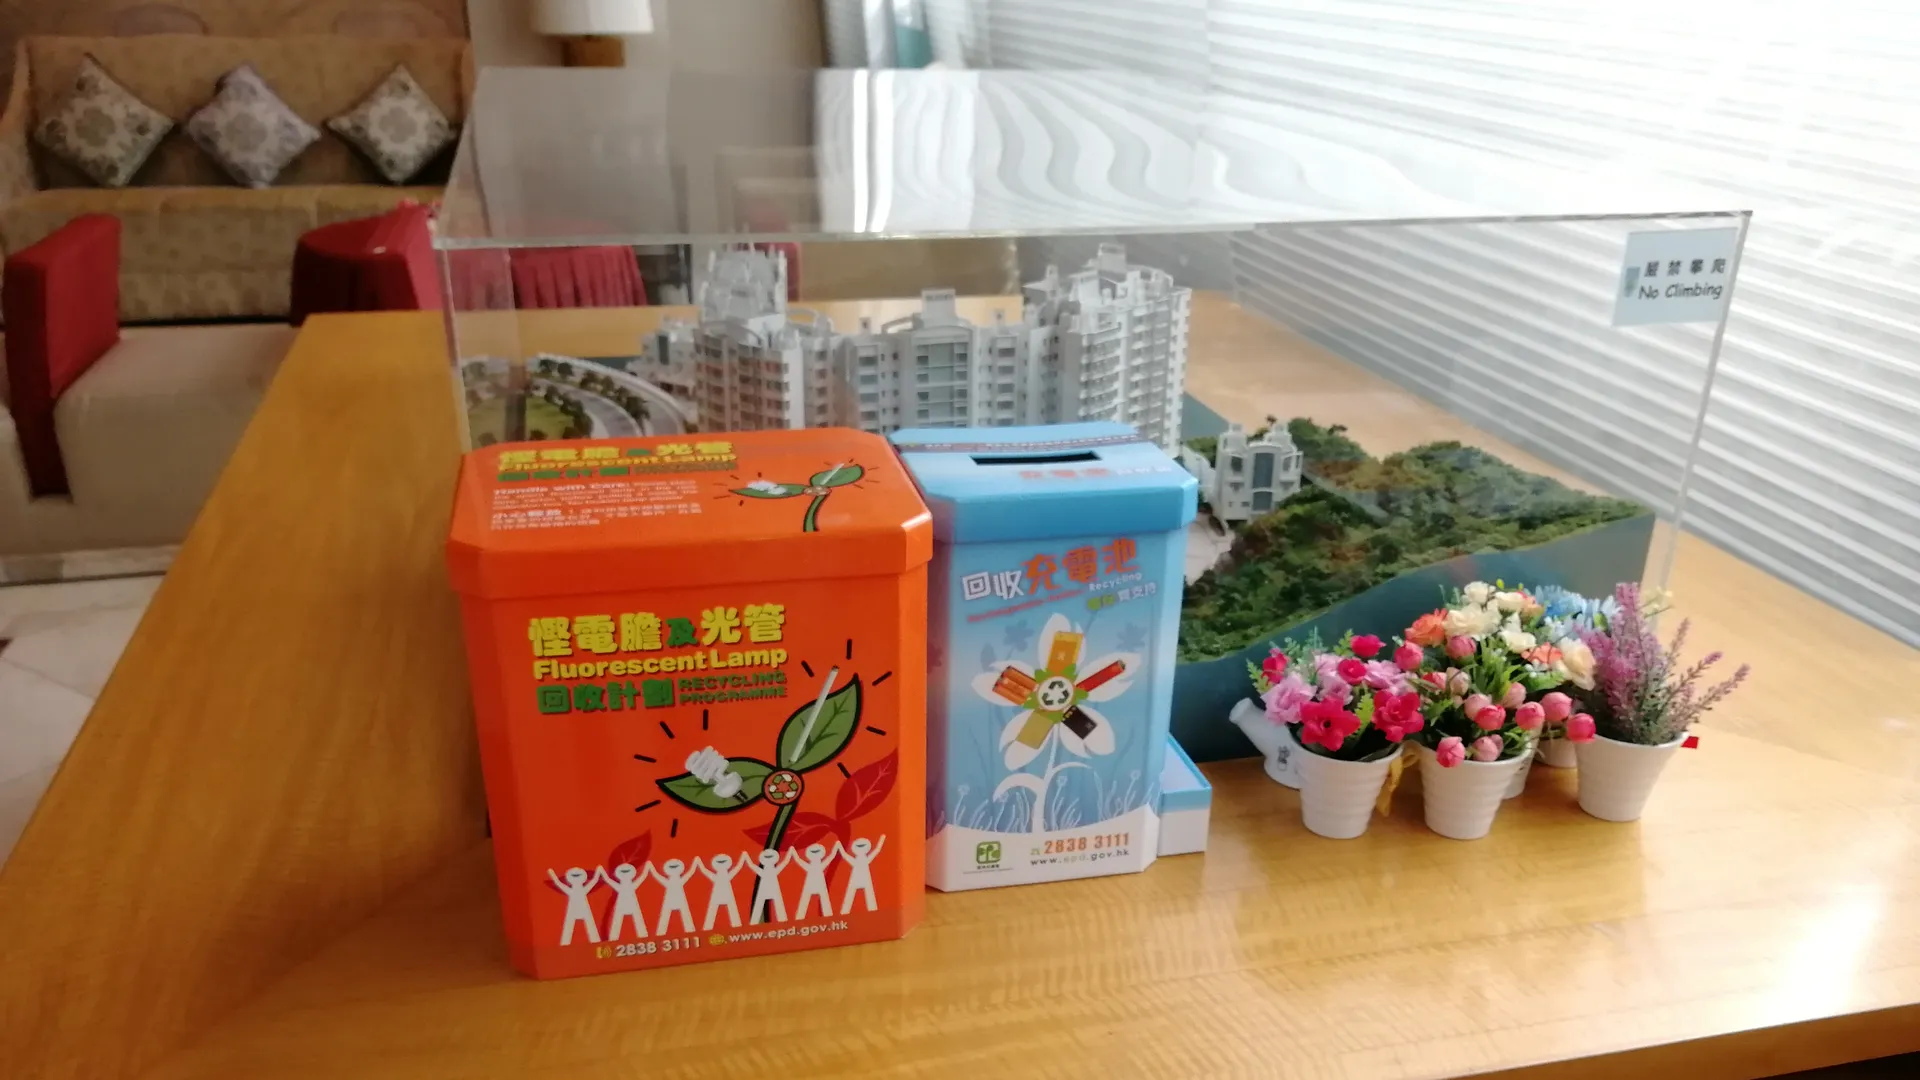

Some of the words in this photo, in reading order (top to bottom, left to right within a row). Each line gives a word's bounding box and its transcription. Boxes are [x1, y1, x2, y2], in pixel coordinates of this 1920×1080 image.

[1638, 285, 1659, 300] No
[1665, 281, 1723, 300] Climbing
[533, 654, 707, 680] Fluorescent
[710, 648, 788, 669] Lamp
[678, 670, 787, 692] RECYCLING
[536, 678, 675, 714] 回收計劃
[679, 685, 787, 705] PROGRAMME
[1044, 837, 1088, 855] 2838
[1094, 832, 1130, 850] 3111
[729, 920, 849, 943] www.epd.gov.hk
[616, 940, 657, 957] 2838
[662, 936, 700, 952] 3111
